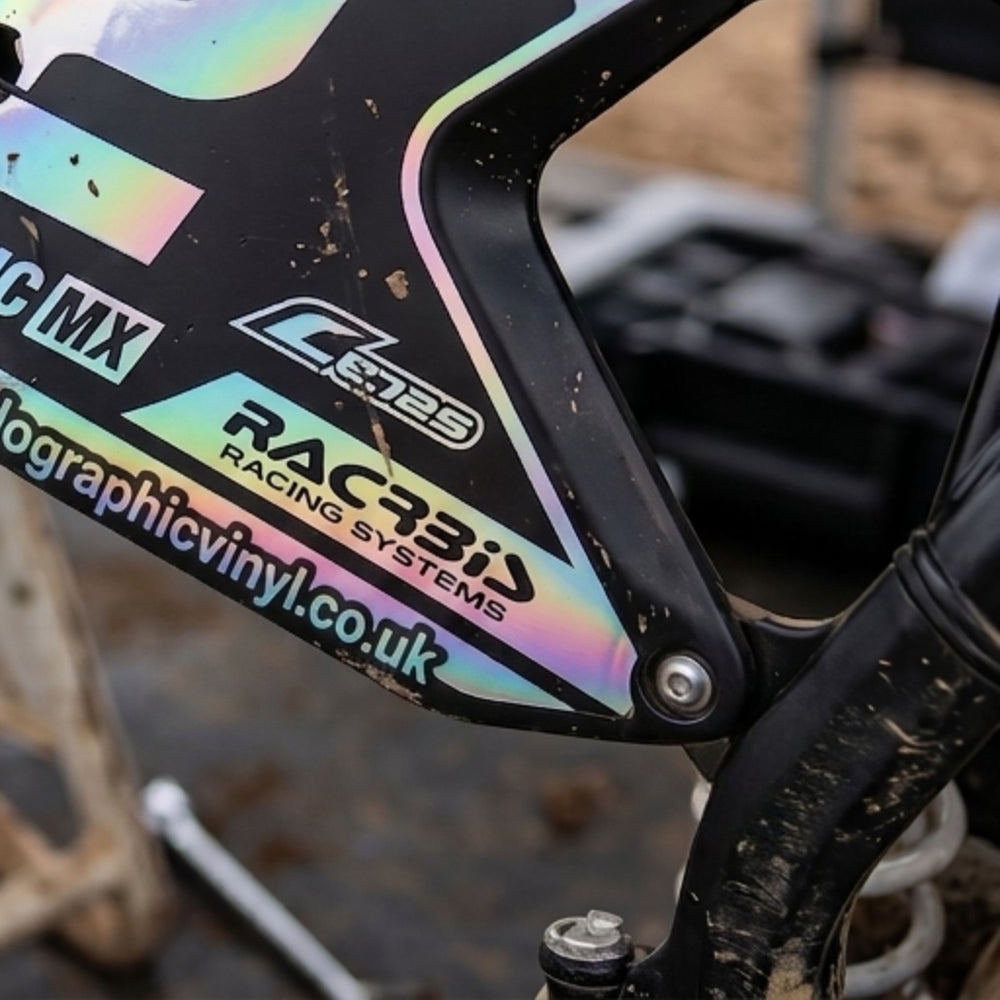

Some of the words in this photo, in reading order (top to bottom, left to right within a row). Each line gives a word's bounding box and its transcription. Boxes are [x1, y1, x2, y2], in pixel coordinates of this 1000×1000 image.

[37, 285, 150, 373] MX
[219, 444, 343, 525] RACING
[350, 523, 506, 622] SYSTEMS
